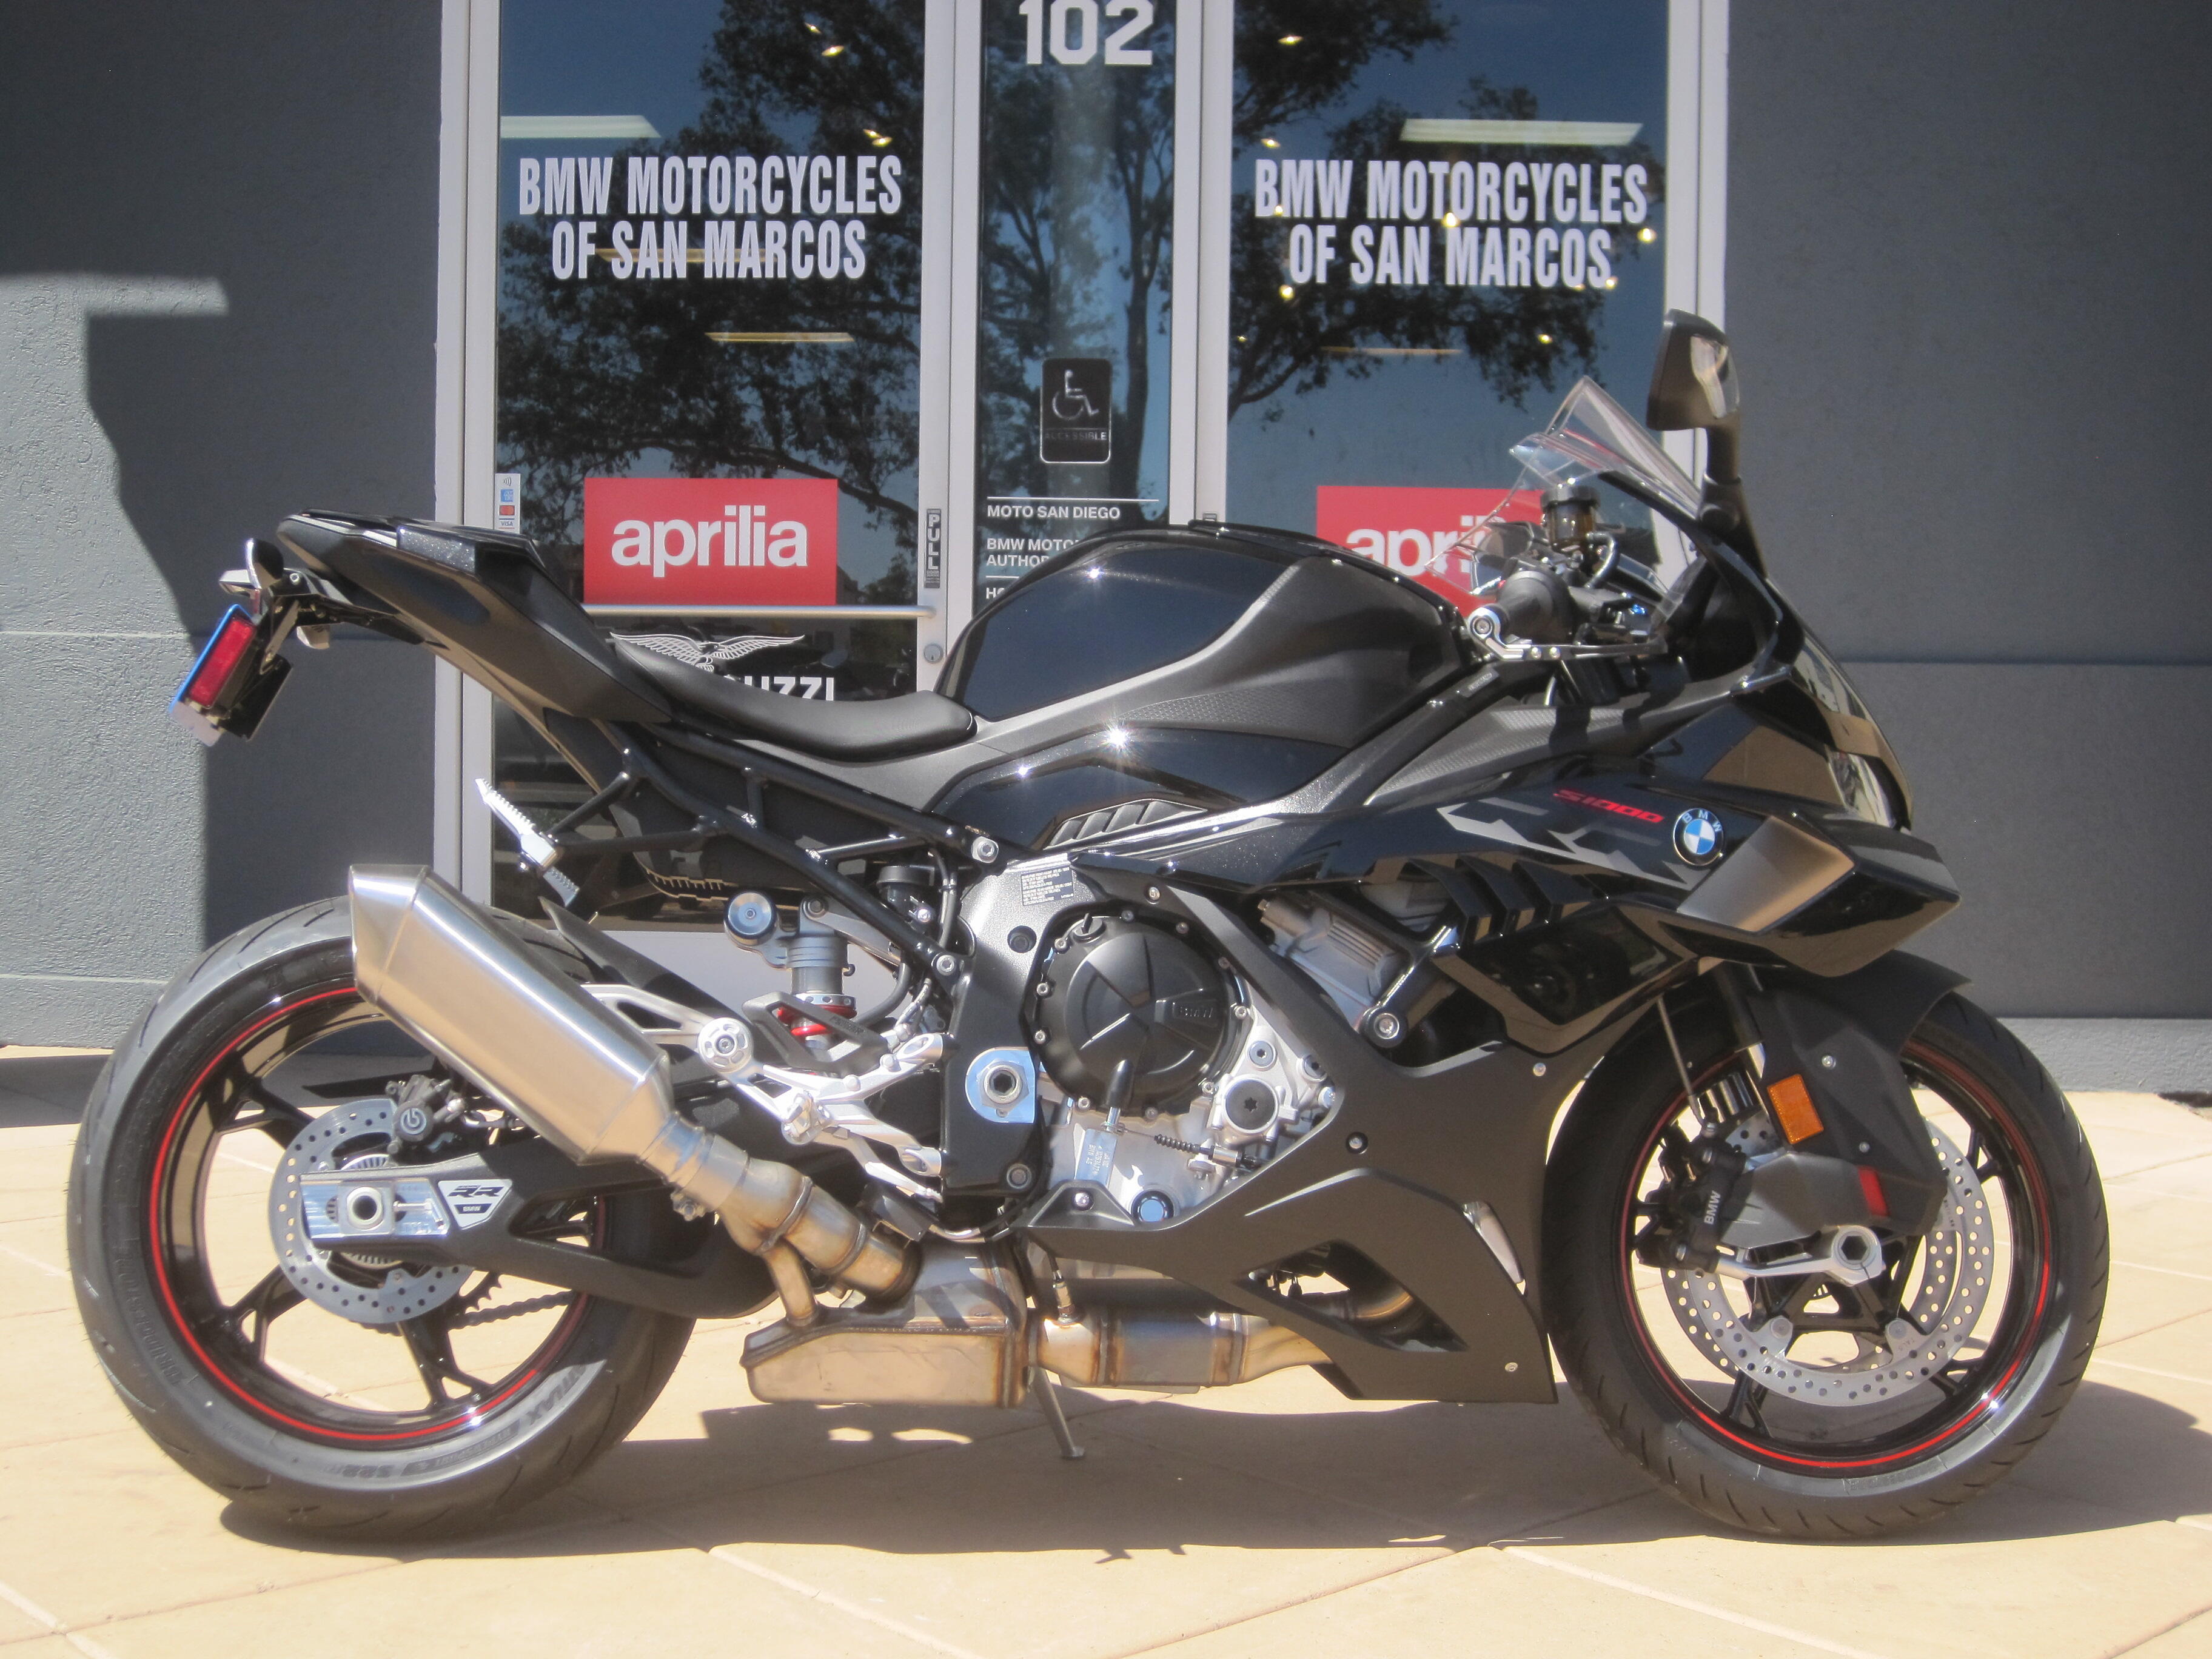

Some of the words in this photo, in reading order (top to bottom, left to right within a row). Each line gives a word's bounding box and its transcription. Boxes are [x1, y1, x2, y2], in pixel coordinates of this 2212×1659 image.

[1019, 0, 1153, 65] 102
[520, 158, 612, 215] BMW
[628, 155, 902, 214] MOTORCYCLES
[1255, 159, 1353, 218] BMW
[1367, 160, 1647, 224] MOTORCYCLES
[552, 221, 597, 280] OF
[612, 221, 687, 279] SAN
[704, 220, 866, 279] MARCOS
[1289, 224, 1336, 284] OF
[1350, 225, 1430, 285] SAN
[1445, 227, 1612, 288] MARCOS
[612, 504, 808, 577] aprilia
[987, 505, 1033, 518] MOTO
[1037, 506, 1068, 518] SAN
[1073, 507, 1121, 519] DIEGO
[928, 514, 940, 569] PULL
[987, 538, 1025, 551] BMW
[1028, 539, 1079, 551] MOTO
[1682, 809, 1722, 832] BMW
[447, 1186, 504, 1198] RR
[1704, 1190, 1721, 1224] BMW
